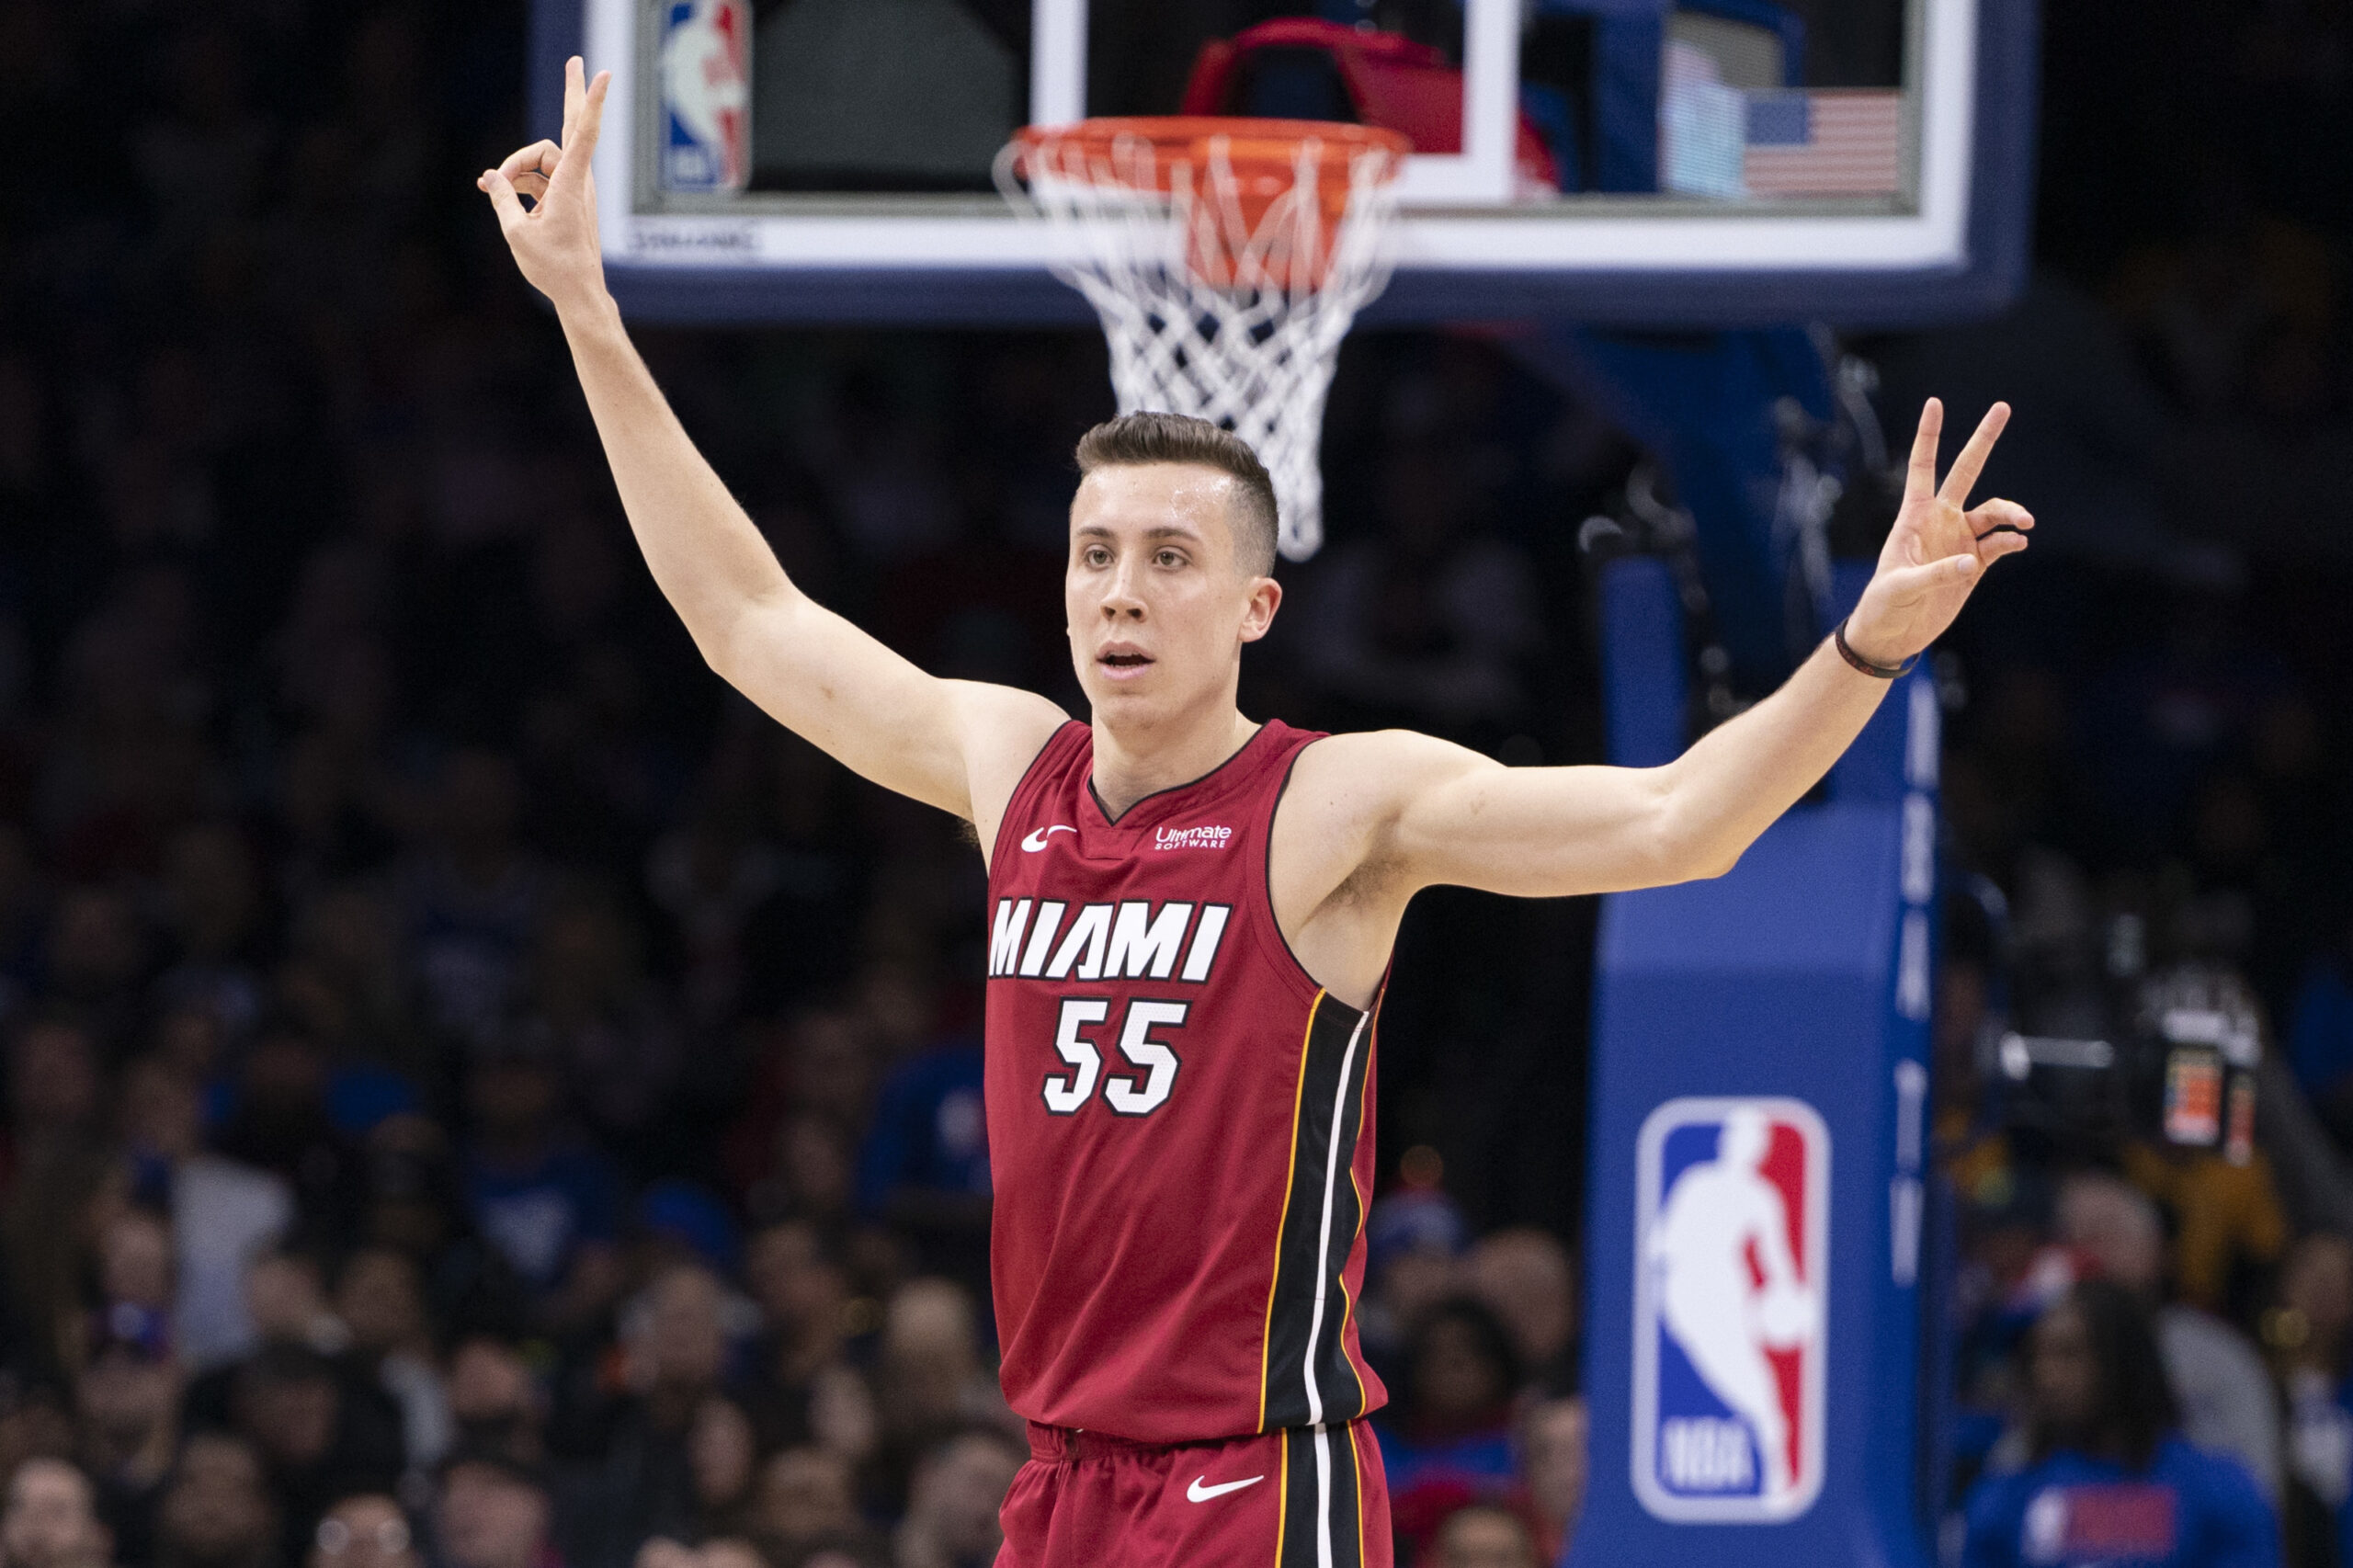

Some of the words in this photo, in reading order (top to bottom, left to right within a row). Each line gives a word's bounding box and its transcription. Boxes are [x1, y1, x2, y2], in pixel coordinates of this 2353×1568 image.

[1154, 839, 1226, 850] SOFTWARE
[1155, 825, 1232, 843] Ultimate
[988, 896, 1233, 984] MIAMI
[1040, 996, 1193, 1117] 55
